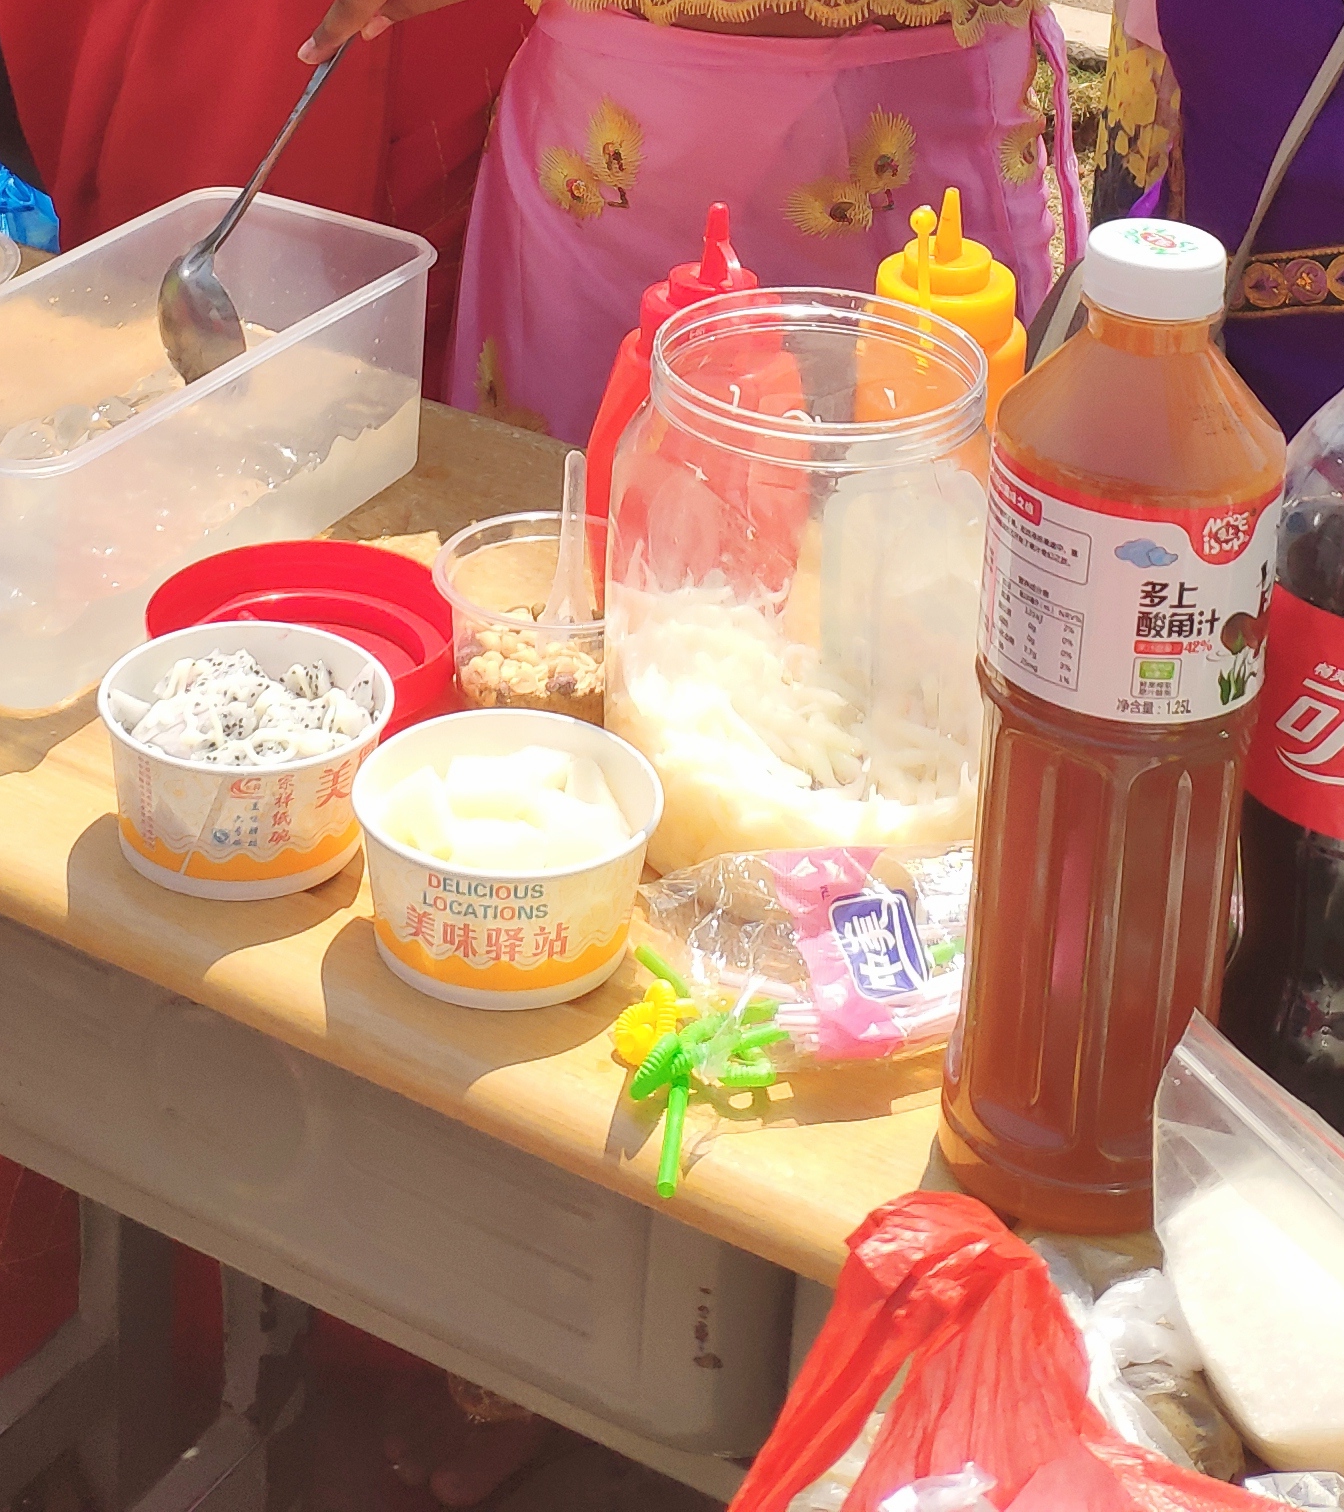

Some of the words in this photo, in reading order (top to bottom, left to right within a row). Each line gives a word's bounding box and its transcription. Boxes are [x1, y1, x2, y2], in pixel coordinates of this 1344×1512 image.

[1139, 580, 1199, 609] 多上
[1135, 607, 1221, 640] 酸角汁
[1183, 639, 1213, 654] 42%
[427, 872, 545, 901] DELICIOUS
[421, 891, 549, 921] LOCATIONS
[404, 903, 571, 963] 美味驿站
